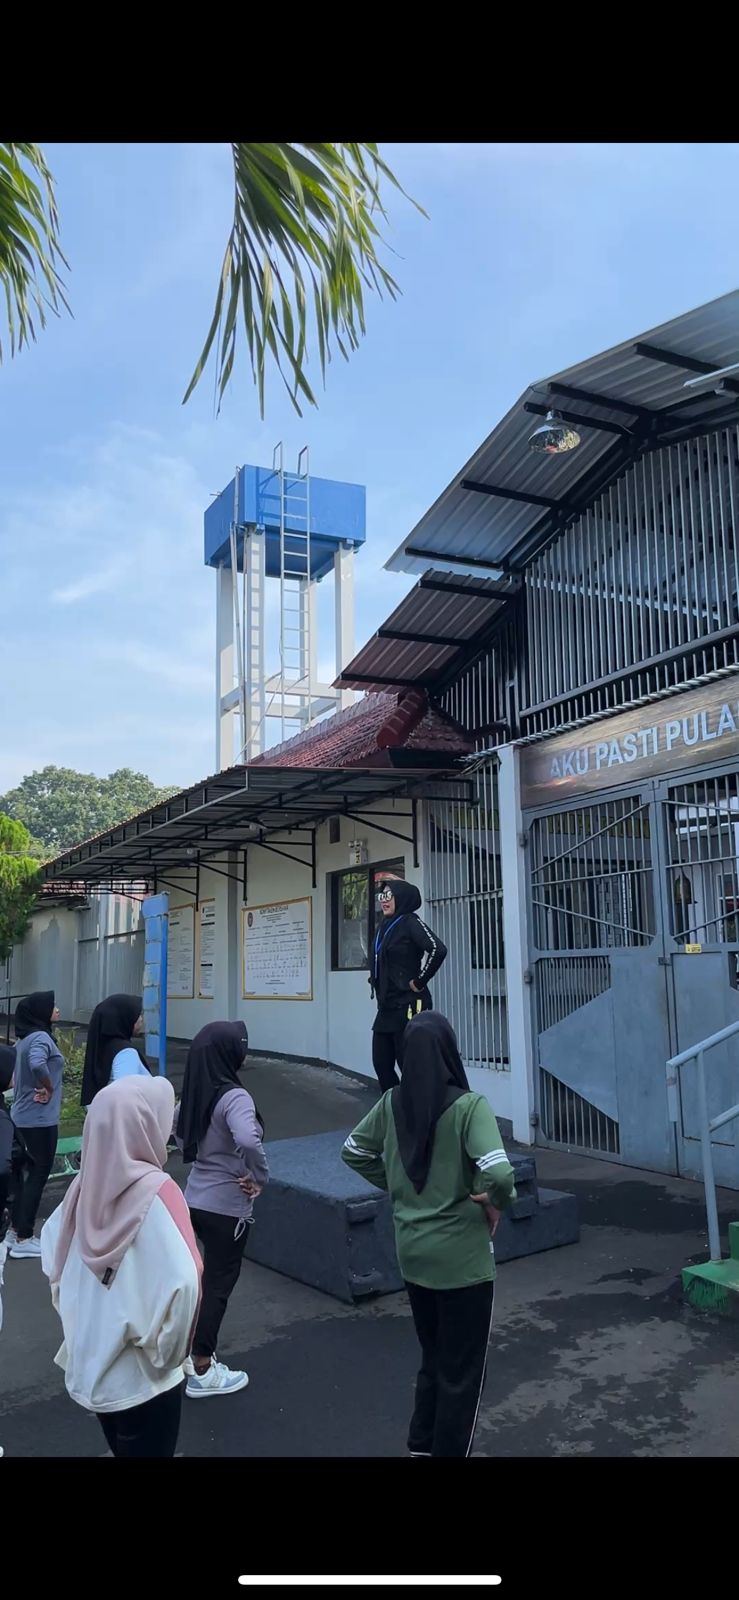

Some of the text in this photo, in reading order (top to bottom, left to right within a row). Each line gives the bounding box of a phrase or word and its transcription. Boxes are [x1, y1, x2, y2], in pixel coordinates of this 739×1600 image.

[550, 702, 739, 778] AKU PASTI PULA
